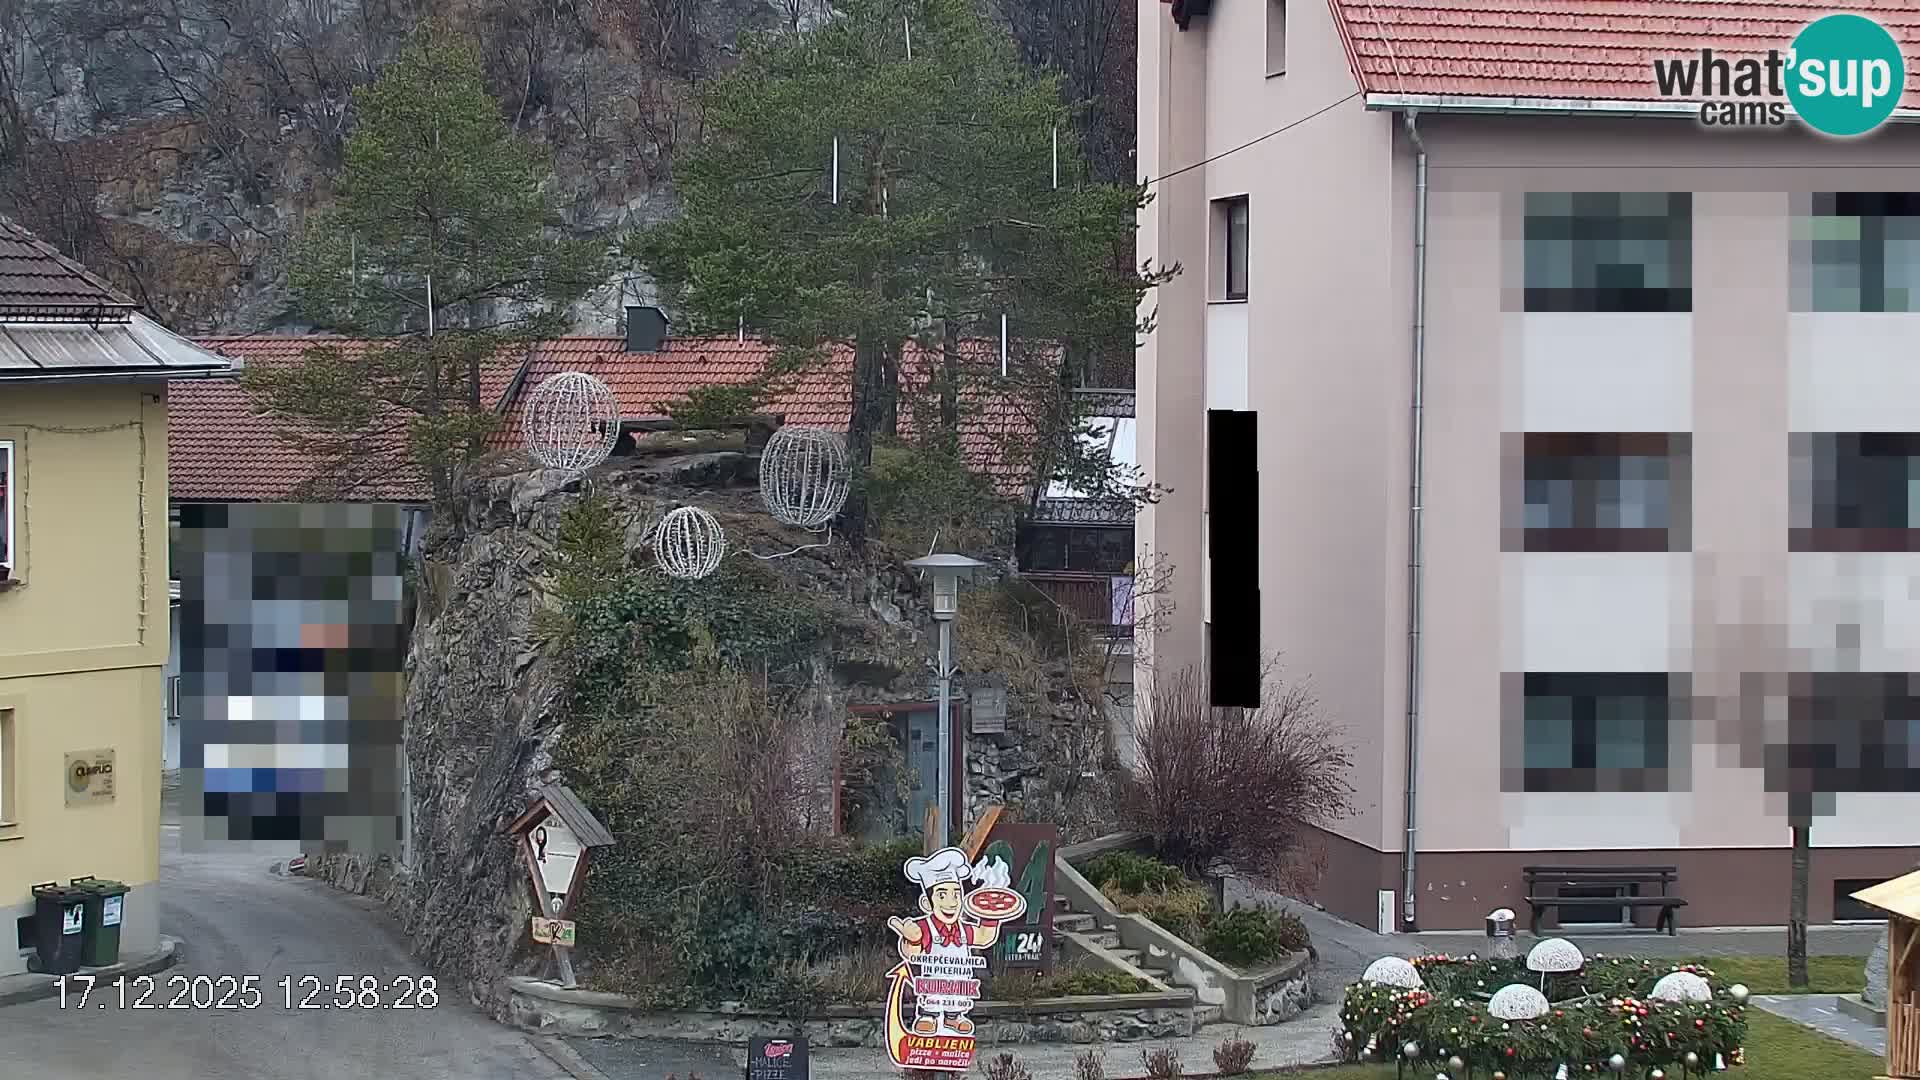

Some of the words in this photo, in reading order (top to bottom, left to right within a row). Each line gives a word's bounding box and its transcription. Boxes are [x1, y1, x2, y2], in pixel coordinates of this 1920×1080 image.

[923, 965, 933, 974] IN
[934, 966, 972, 976] PICERIJA
[907, 1037, 975, 1051] VABLJENI
